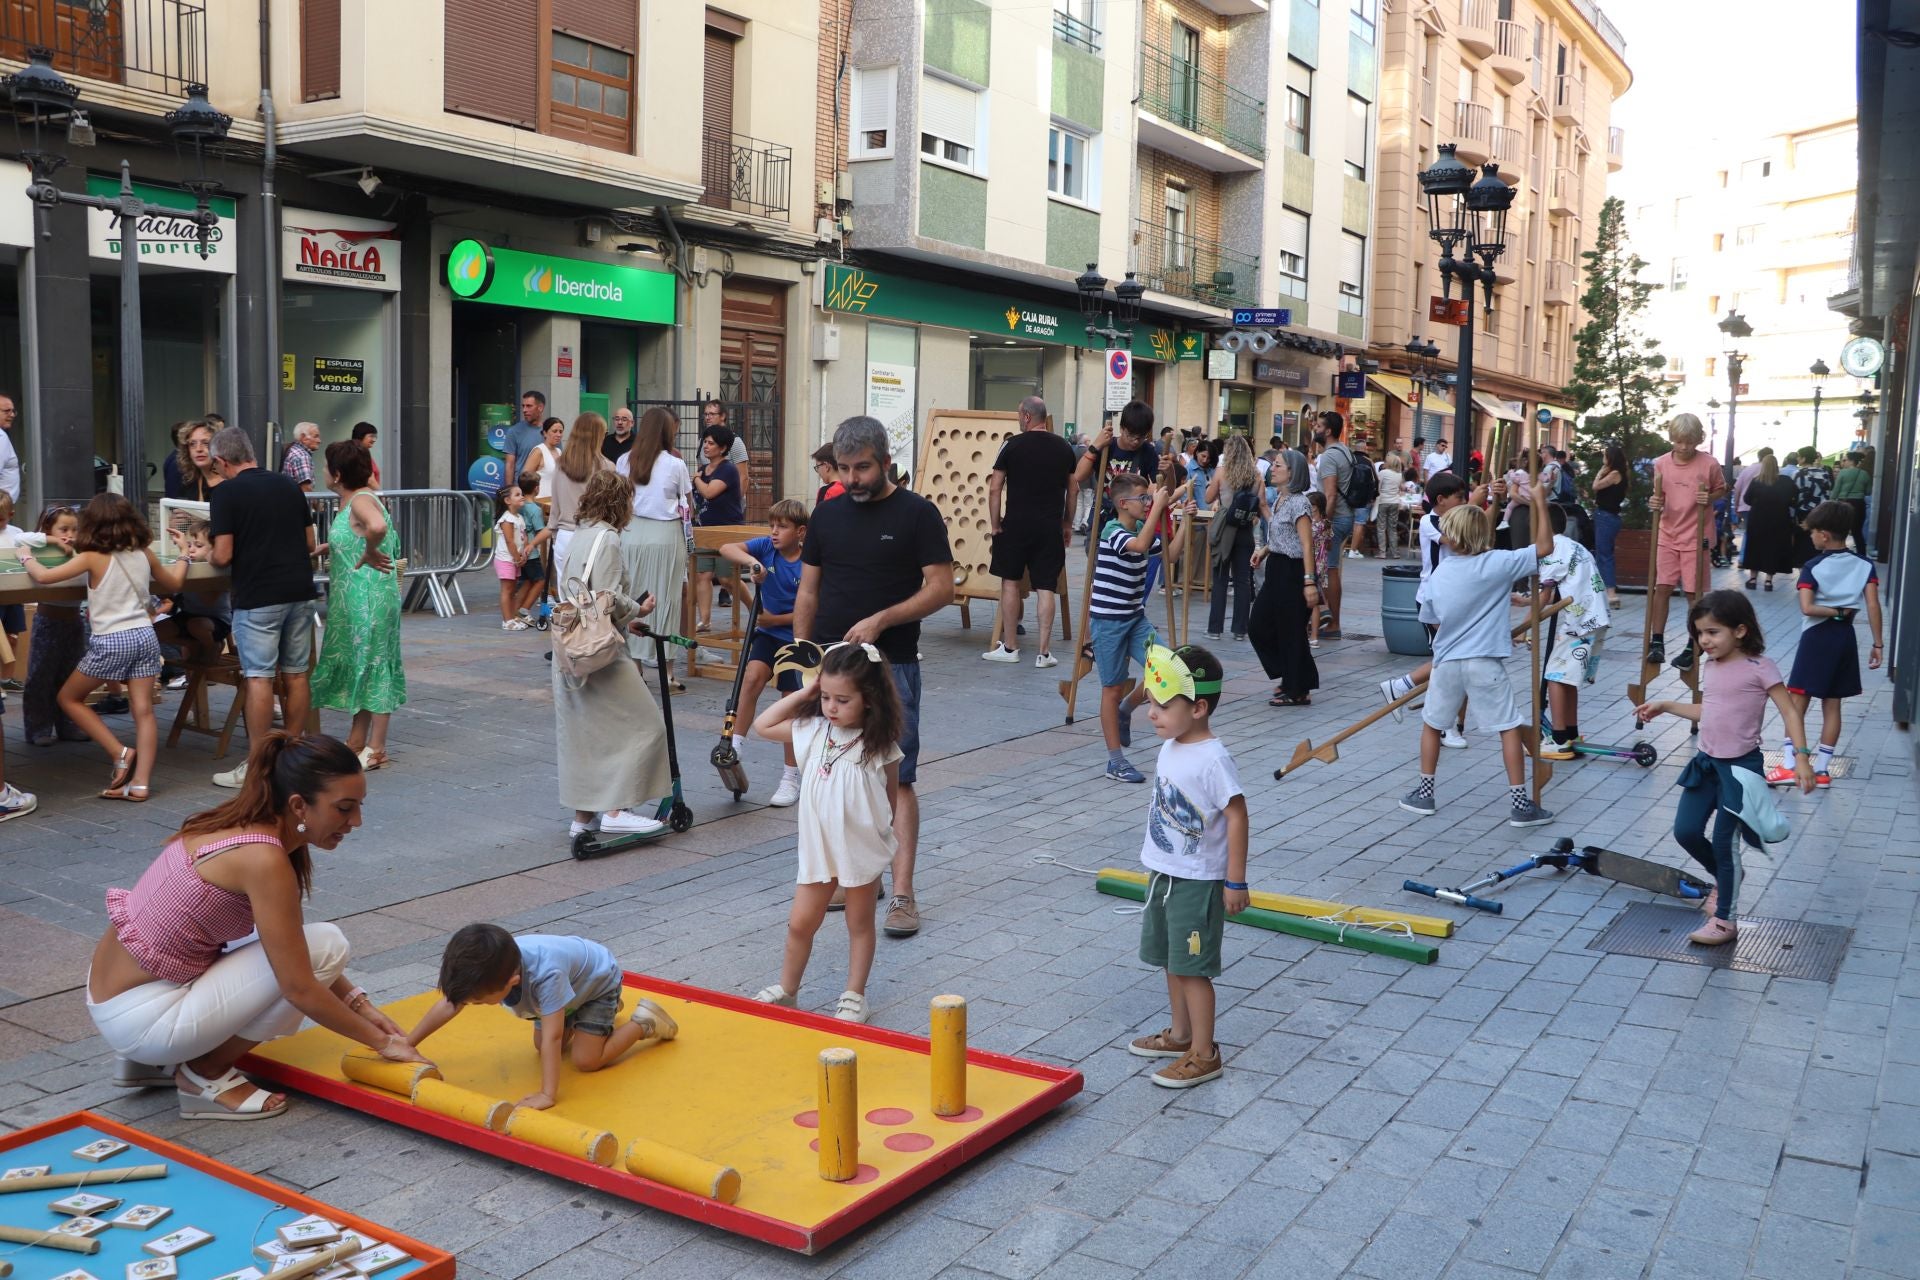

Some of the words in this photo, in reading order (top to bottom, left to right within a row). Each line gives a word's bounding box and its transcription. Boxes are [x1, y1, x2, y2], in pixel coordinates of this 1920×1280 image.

[109, 241, 217, 254] Dportes
[555, 273, 623, 302] Iberdrola
[1021, 311, 1038, 323] CAJA
[1038, 313, 1059, 327] RURAL
[1025, 324, 1033, 333] DE
[327, 360, 363, 368] ESPUELAS
[320, 374, 358, 384] vende
